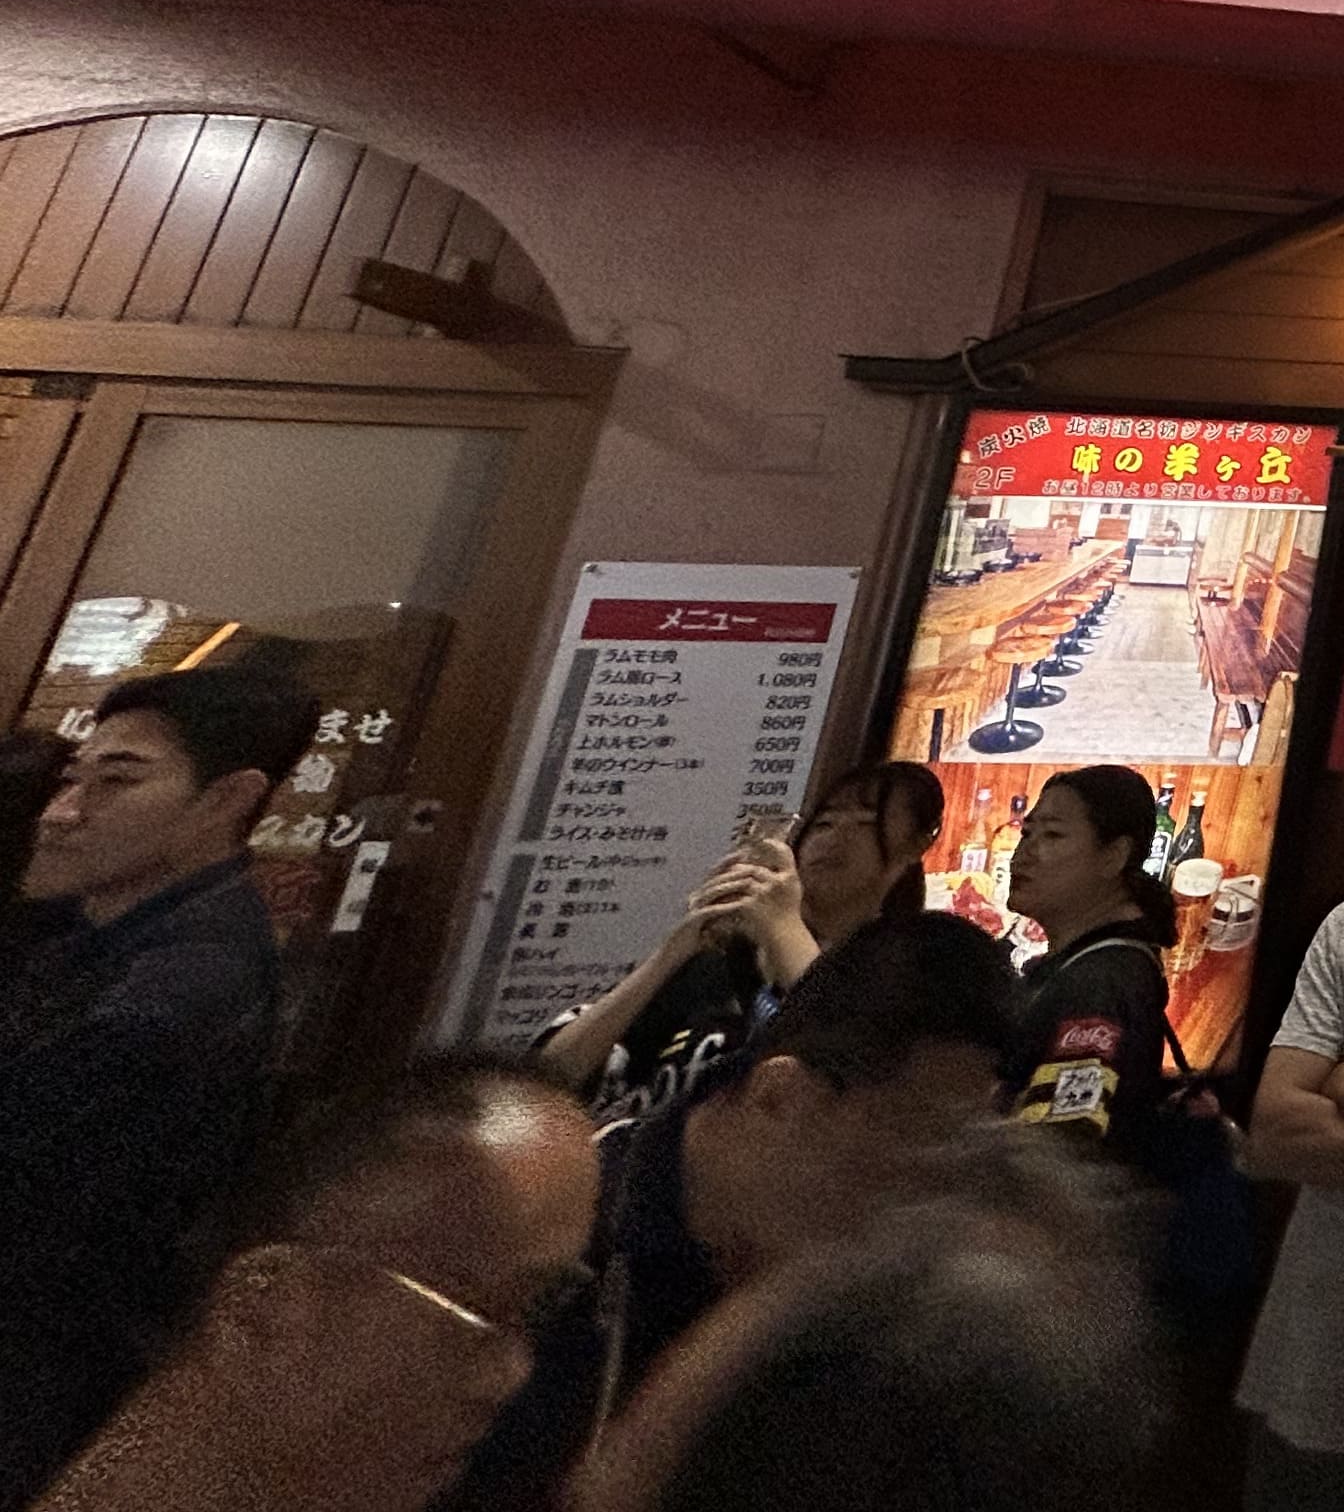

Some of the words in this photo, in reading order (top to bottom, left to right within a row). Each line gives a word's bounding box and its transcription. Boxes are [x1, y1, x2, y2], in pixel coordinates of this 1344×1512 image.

[977, 416, 1052, 458] 炭火焼
[974, 467, 1016, 490] 2F
[1071, 442, 1293, 486] 味の羊ヶ丘
[658, 607, 758, 631] メニュー
